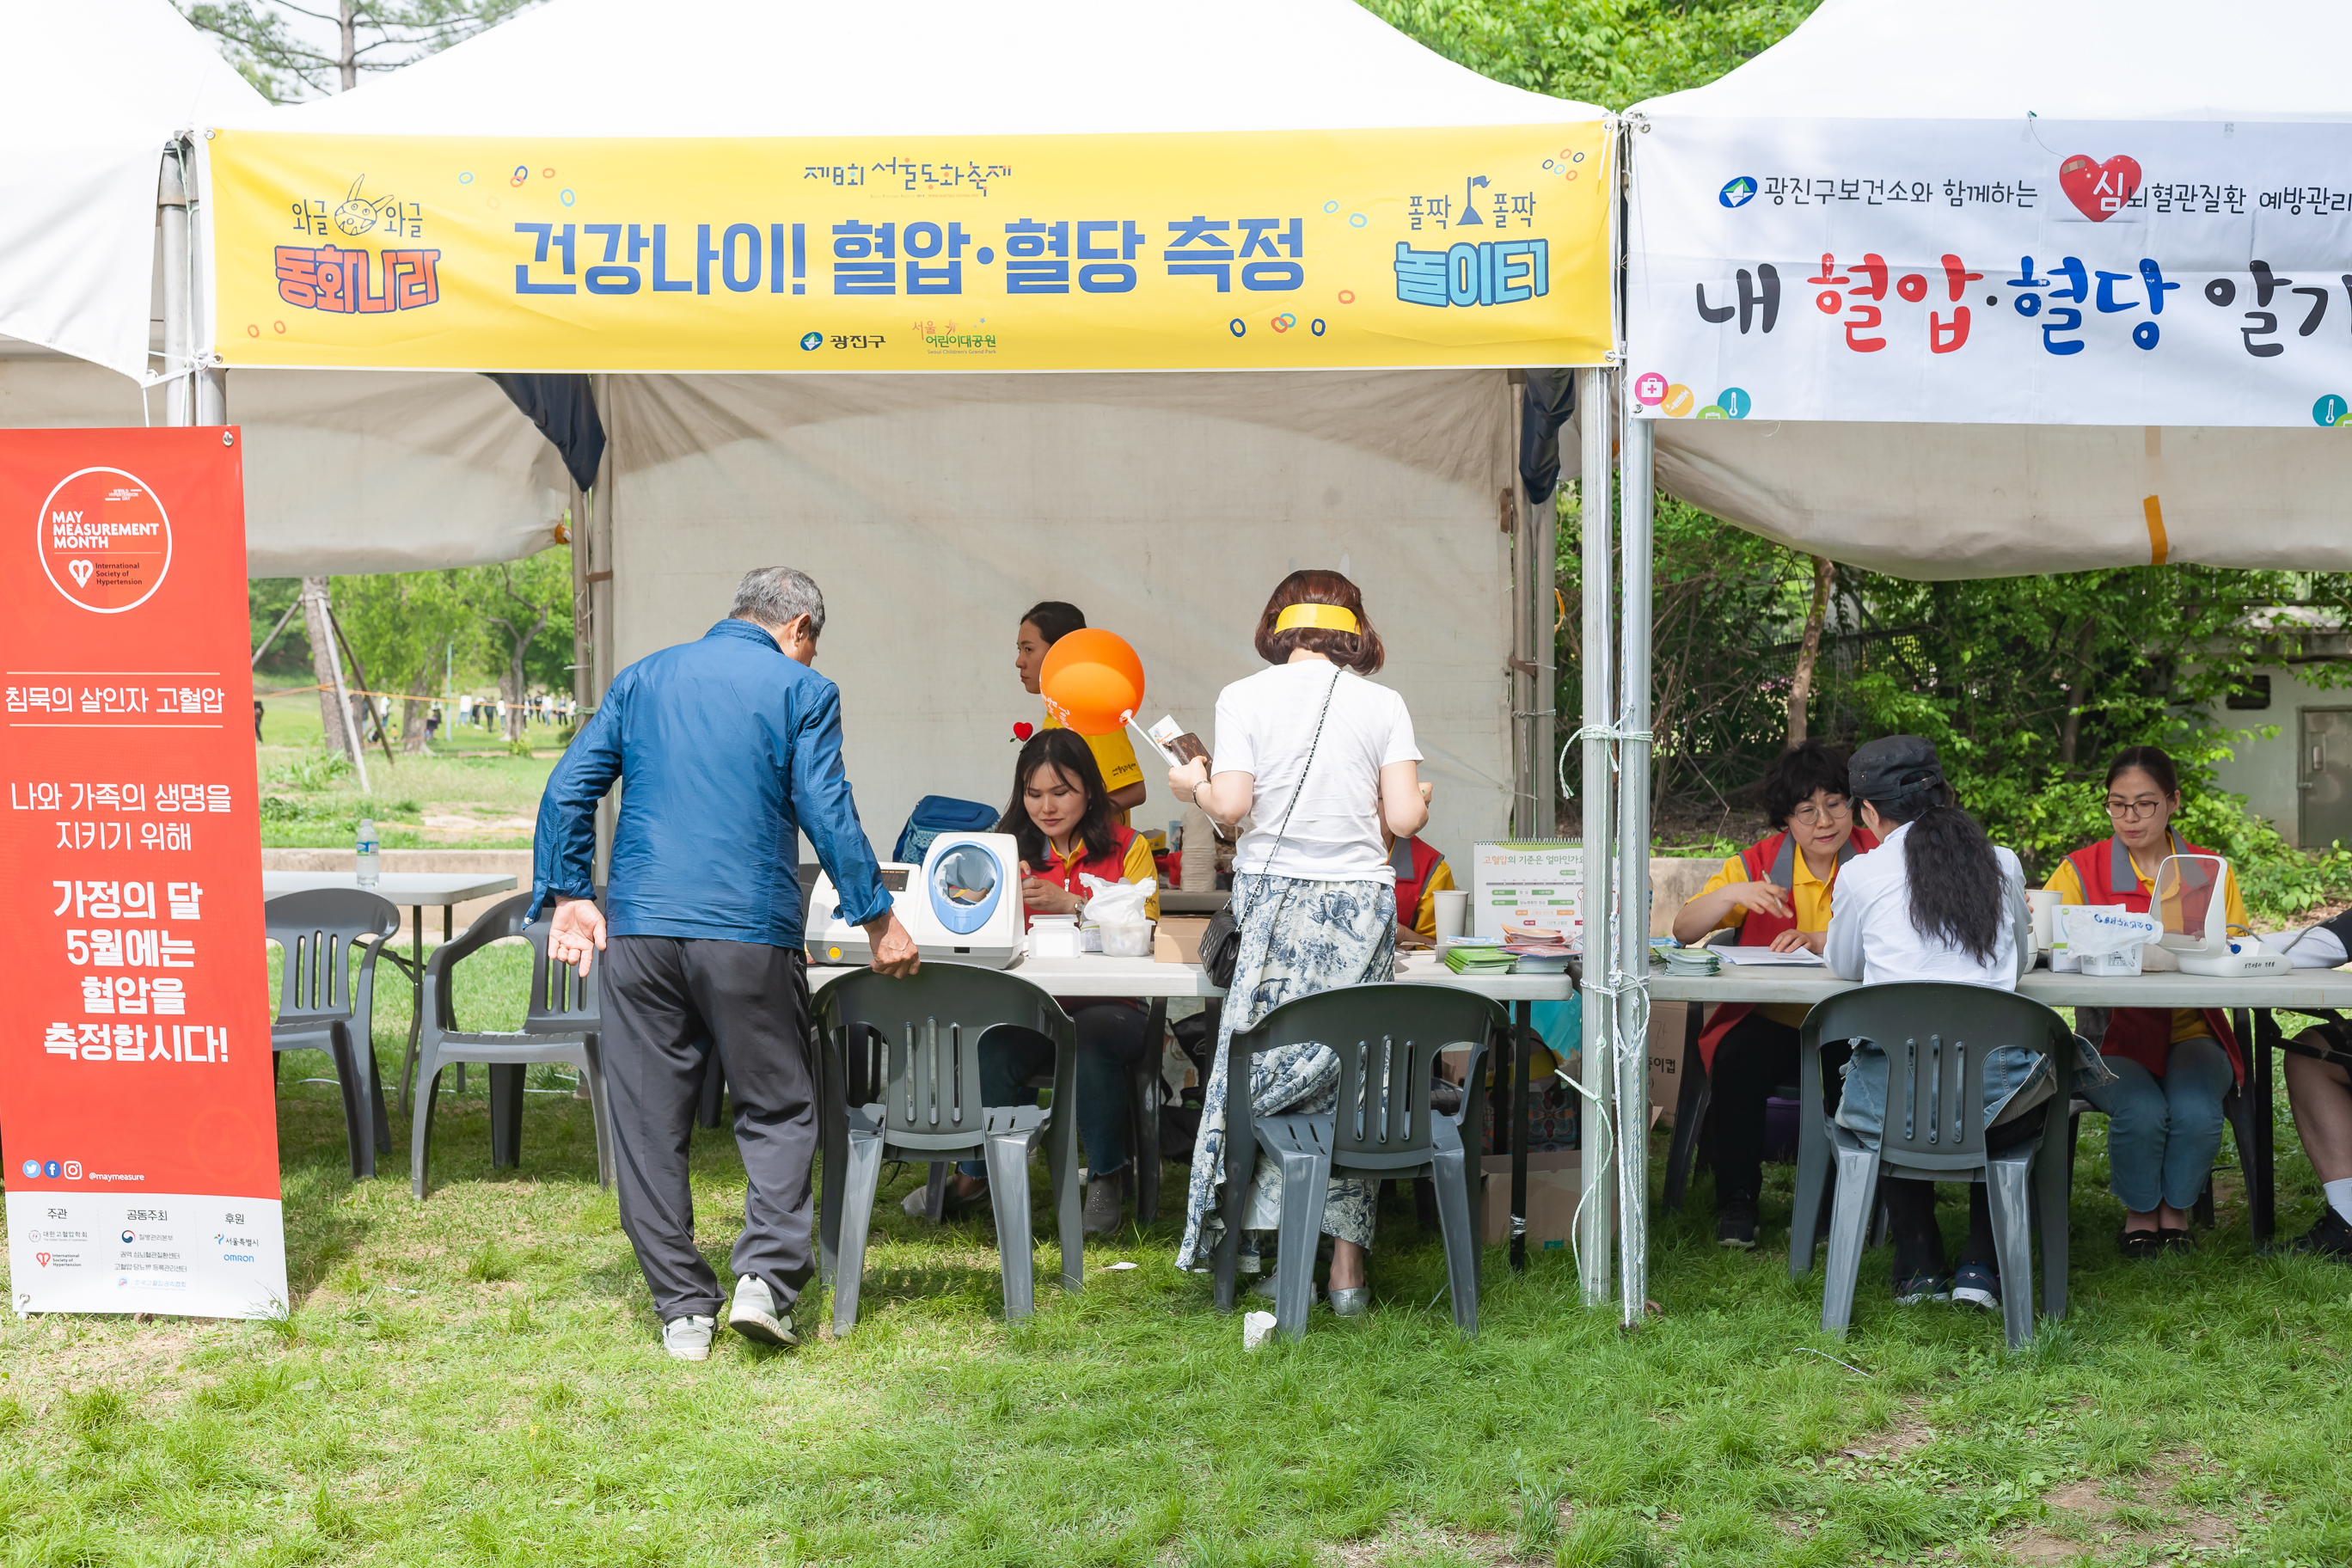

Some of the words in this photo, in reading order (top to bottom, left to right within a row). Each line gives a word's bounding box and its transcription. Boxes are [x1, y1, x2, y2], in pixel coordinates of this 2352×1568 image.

[872, 156, 1012, 197] 서울동화축제
[1764, 179, 1933, 209] 광진구보건소와
[1943, 181, 2038, 209] 함께하는
[2092, 170, 2247, 215] 심뇌혈관질환
[2259, 187, 2352, 215] 예방관리
[291, 199, 328, 236] 와글
[385, 201, 423, 239] 와글
[1408, 192, 1452, 230] 폴짝
[1492, 190, 1537, 228] 폴짝
[514, 222, 806, 296] 건강나이!
[830, 216, 1146, 296] 혈압·혈당
[1163, 216, 1305, 294] 측정
[274, 243, 441, 315] 동화나라
[1393, 237, 1549, 309] 놀이터
[1696, 262, 1781, 335] 내
[1806, 252, 2182, 357] 혈압·혈당
[2204, 260, 2352, 358] 알기
[830, 335, 886, 349] 광진구
[926, 334, 996, 348] 어린이대공원
[912, 321, 937, 340] 서울
[52, 511, 83, 524] MAY
[52, 523, 159, 536] MEASUREMENT
[53, 536, 109, 548] MONTH
[96, 578, 143, 586] Hypertension
[5, 687, 73, 713] 침묵의
[79, 687, 150, 713] 살인자
[156, 687, 225, 714] 고혈압
[10, 782, 63, 811] 나와
[70, 783, 146, 812] 가족의
[155, 783, 232, 812] 생명을
[56, 822, 132, 850] 지키기
[140, 822, 192, 851] 위해
[1483, 855, 1516, 865] 고혈압의
[1519, 855, 1543, 865] 기준은
[52, 880, 156, 919] 가정의
[167, 881, 203, 920] 달
[66, 928, 195, 967] 5월에는
[81, 976, 187, 1015] 혈압을
[44, 1021, 229, 1063] 측정합시다!
[89, 1172, 144, 1182] @maymeasure
[47, 1208, 68, 1220] 주관
[126, 1209, 168, 1222] 공동주최
[224, 1212, 245, 1225] 후원
[225, 1237, 259, 1247] 서울특별시
